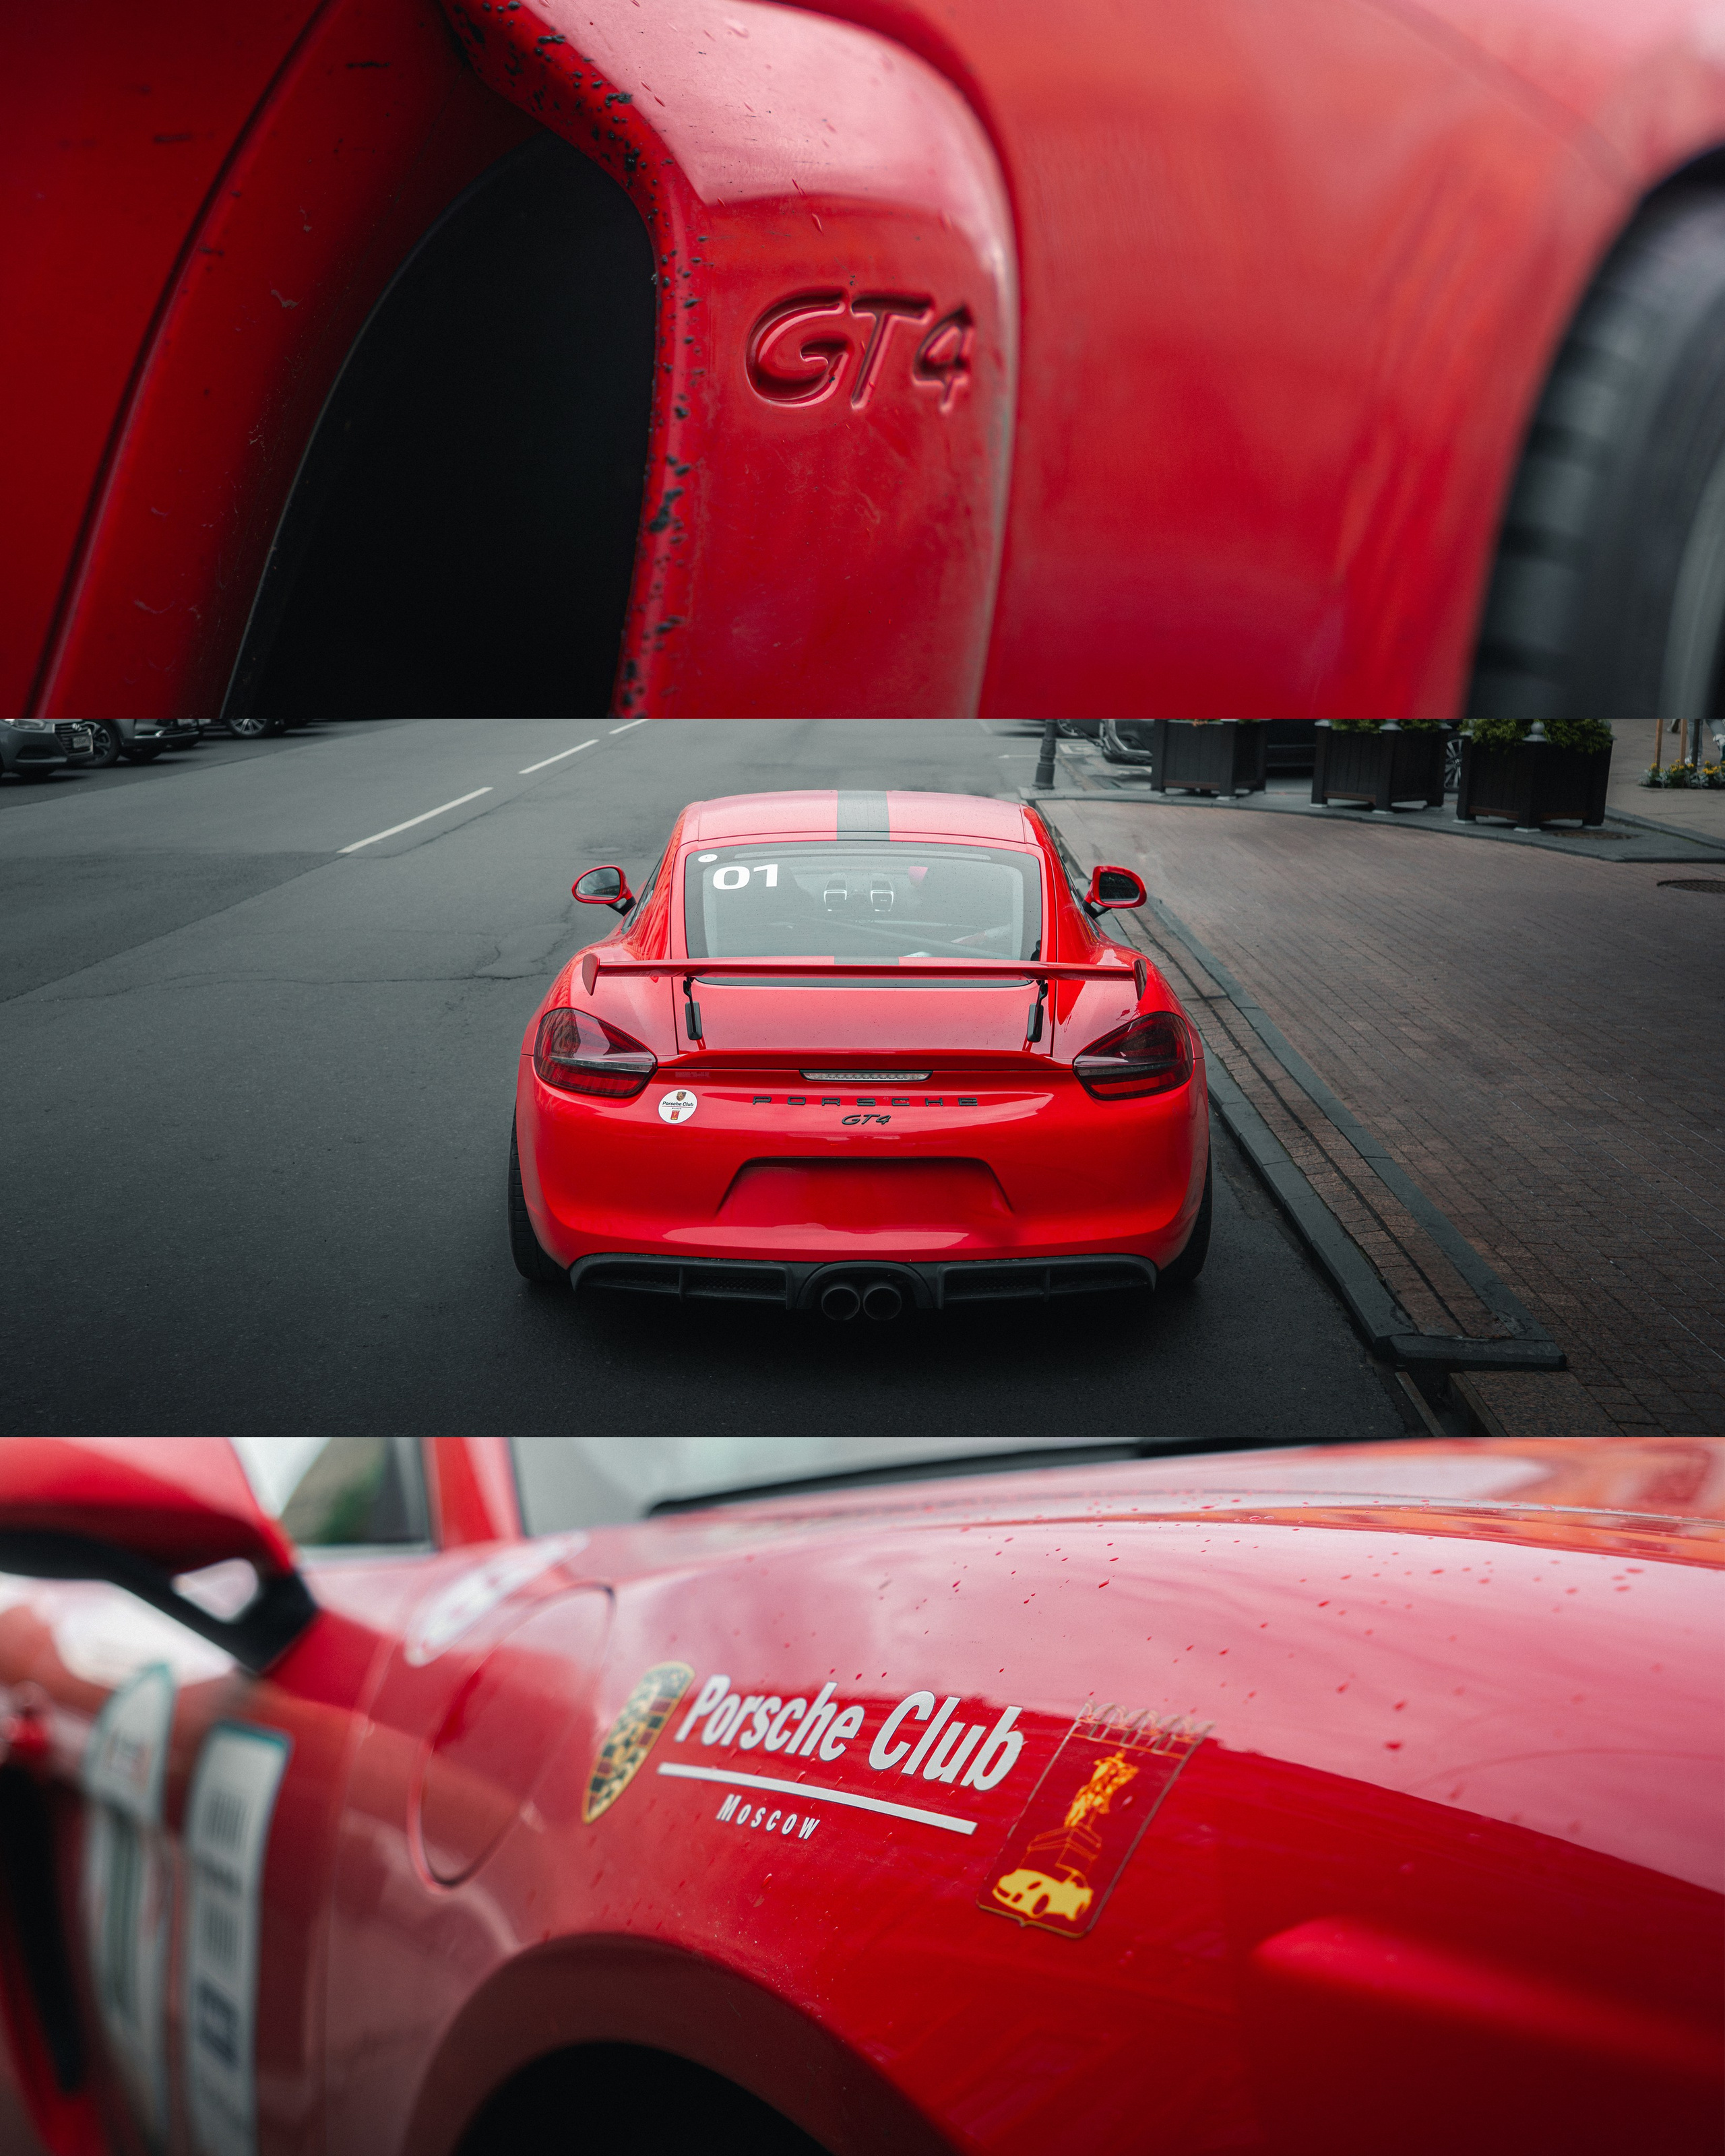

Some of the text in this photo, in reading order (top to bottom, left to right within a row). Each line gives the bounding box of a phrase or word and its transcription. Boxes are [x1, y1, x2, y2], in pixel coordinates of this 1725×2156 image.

[745, 287, 974, 414] GT4
[713, 864, 778, 890] 01
[753, 1096, 978, 1107] PORSCHE
[842, 1114, 891, 1125] GT4
[675, 1675, 1025, 1791] Porsche Club
